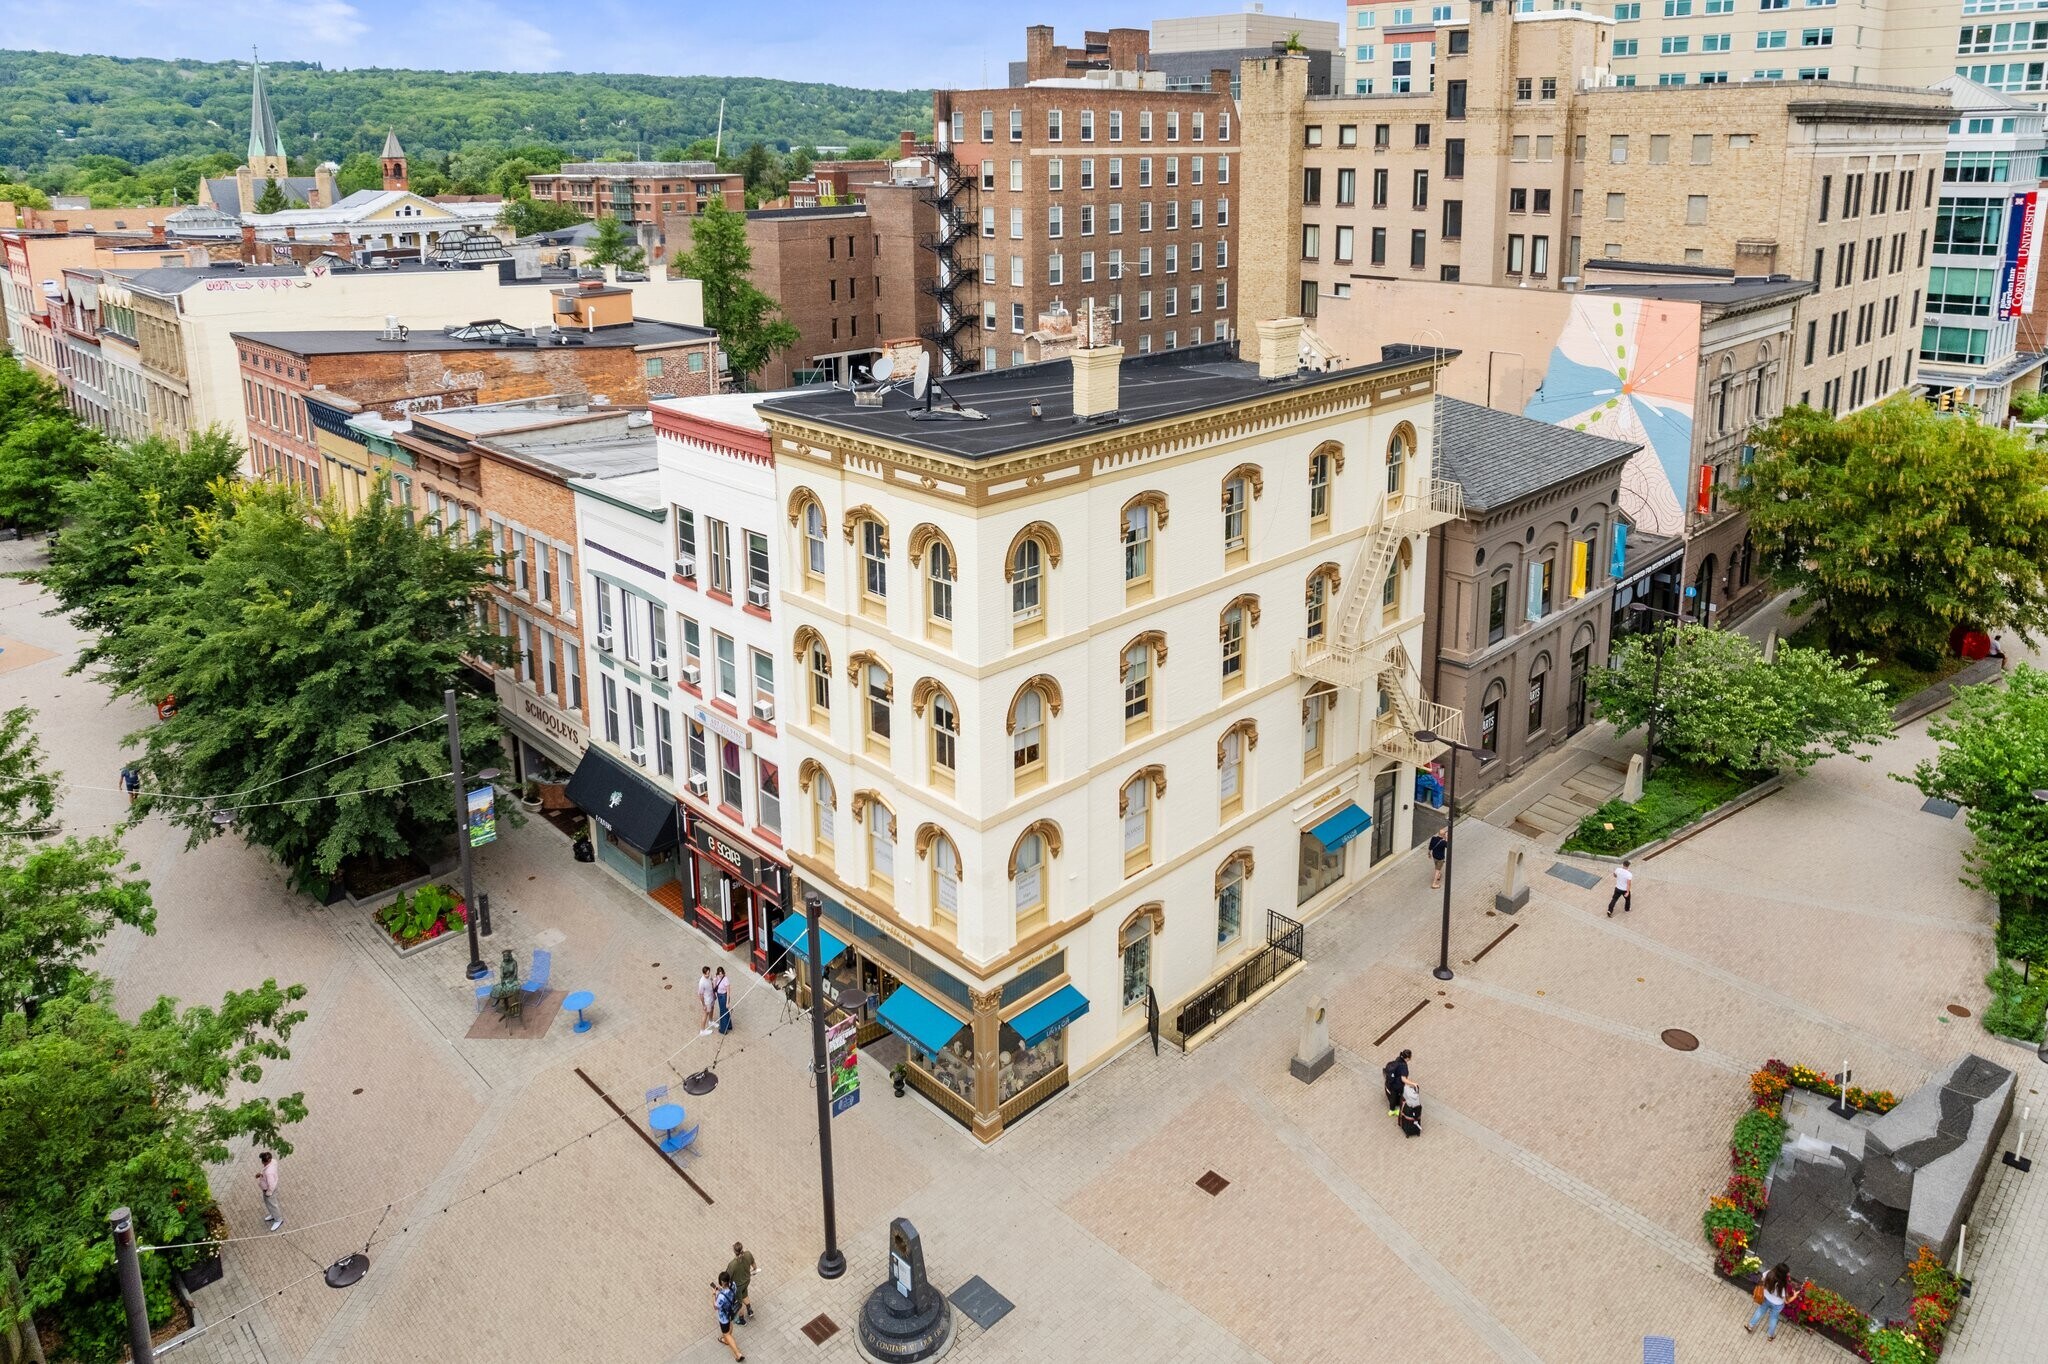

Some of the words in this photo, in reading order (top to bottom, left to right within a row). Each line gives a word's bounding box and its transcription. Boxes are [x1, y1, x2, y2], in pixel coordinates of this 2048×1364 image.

[2018, 202, 2036, 258] UNIVERSITY
[2011, 264, 2027, 307] CORNELL
[525, 699, 579, 744] SCHOOLEYS
